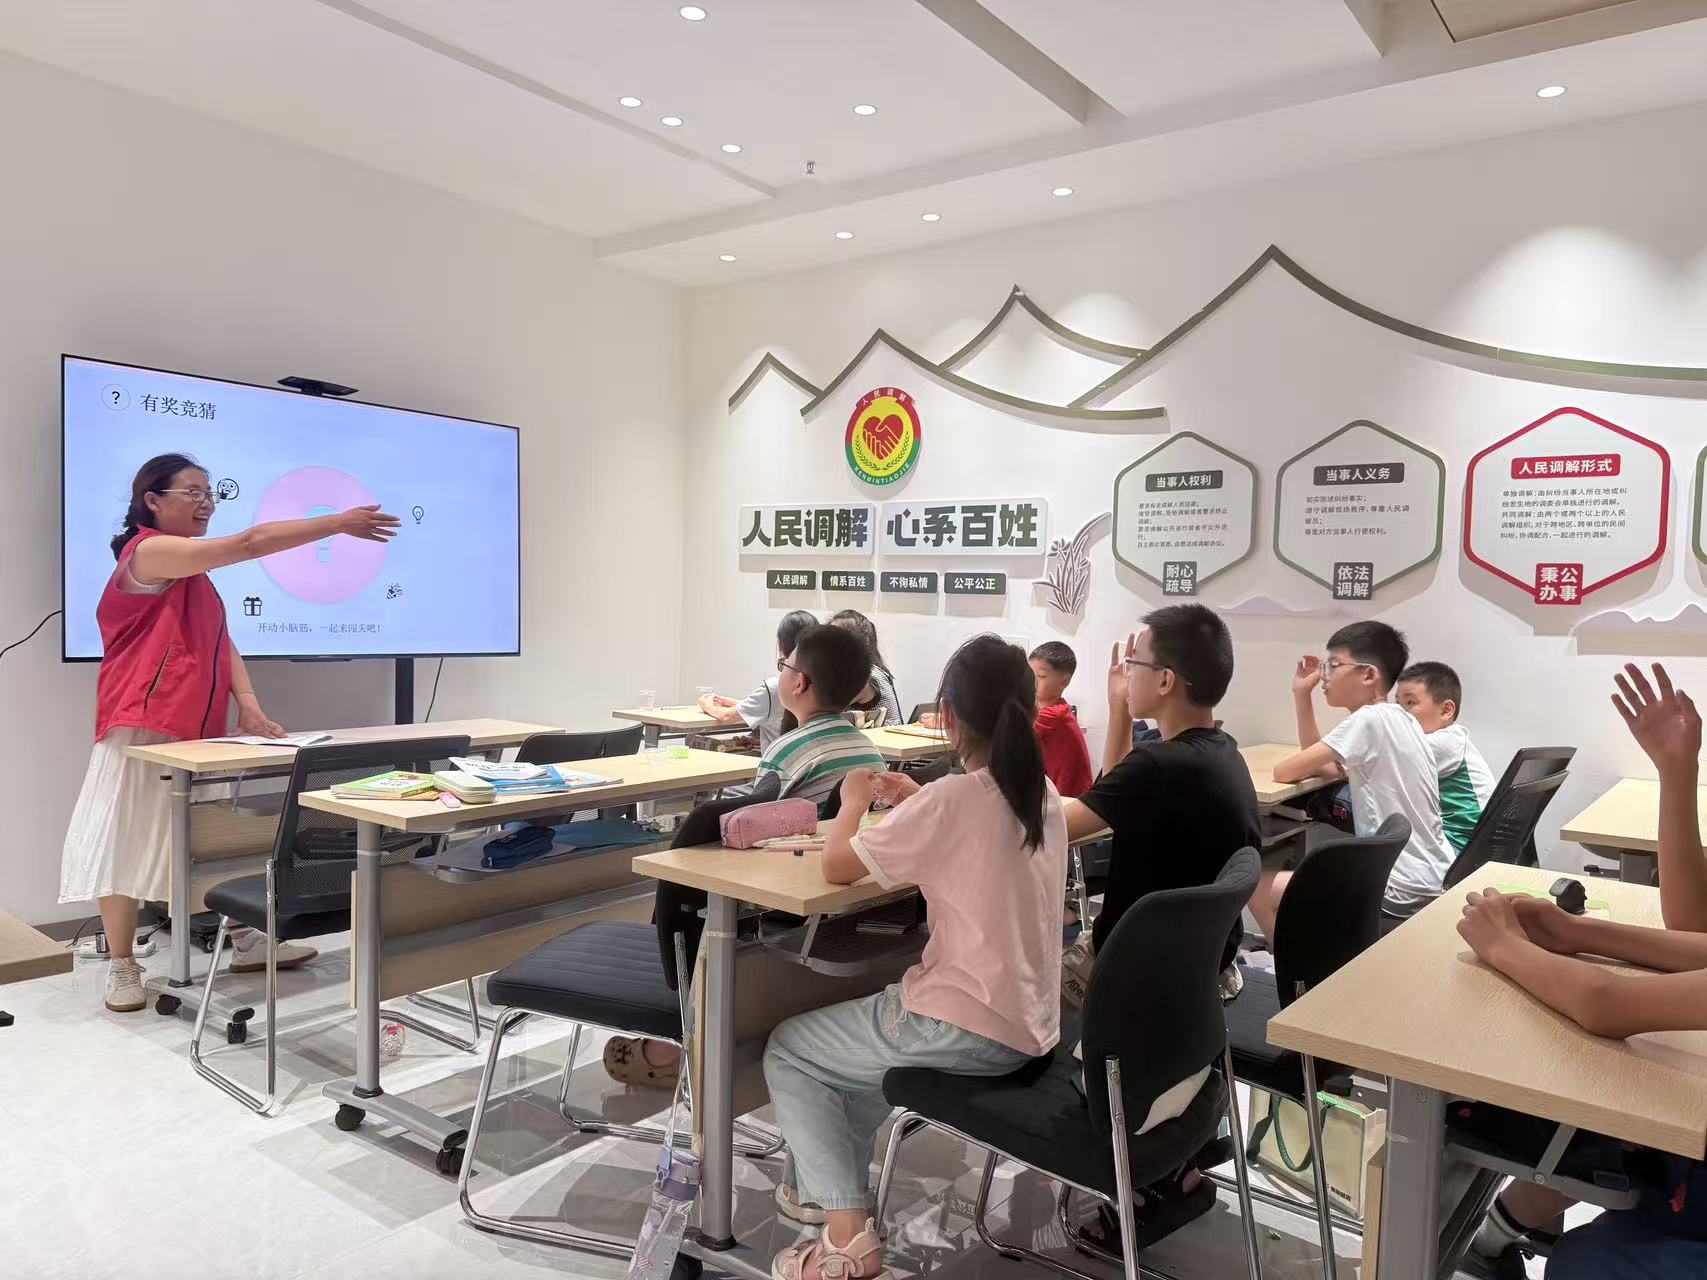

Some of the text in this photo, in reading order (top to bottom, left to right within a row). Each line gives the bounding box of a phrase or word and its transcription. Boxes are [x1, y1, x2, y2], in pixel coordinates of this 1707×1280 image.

[140, 394, 217, 420] 有奖竞猜
[1518, 458, 1613, 475] 人民调解形式
[1156, 475, 1212, 488] 当事人权利
[1326, 467, 1391, 482] 当事人义务
[742, 507, 868, 548] 人民调解
[886, 503, 1038, 548] 心系百姓
[1166, 564, 1194, 578] 耐心
[1337, 565, 1369, 581] 依法
[1540, 567, 1578, 584] 秉公
[774, 574, 808, 586] 人民调解
[829, 575, 866, 588] 情系百姓
[889, 576, 929, 588] 不徇私情
[954, 577, 996, 590] 公平公正
[1165, 579, 1193, 593] 疏导
[1337, 581, 1369, 597] 调解
[1539, 585, 1578, 601] 办事
